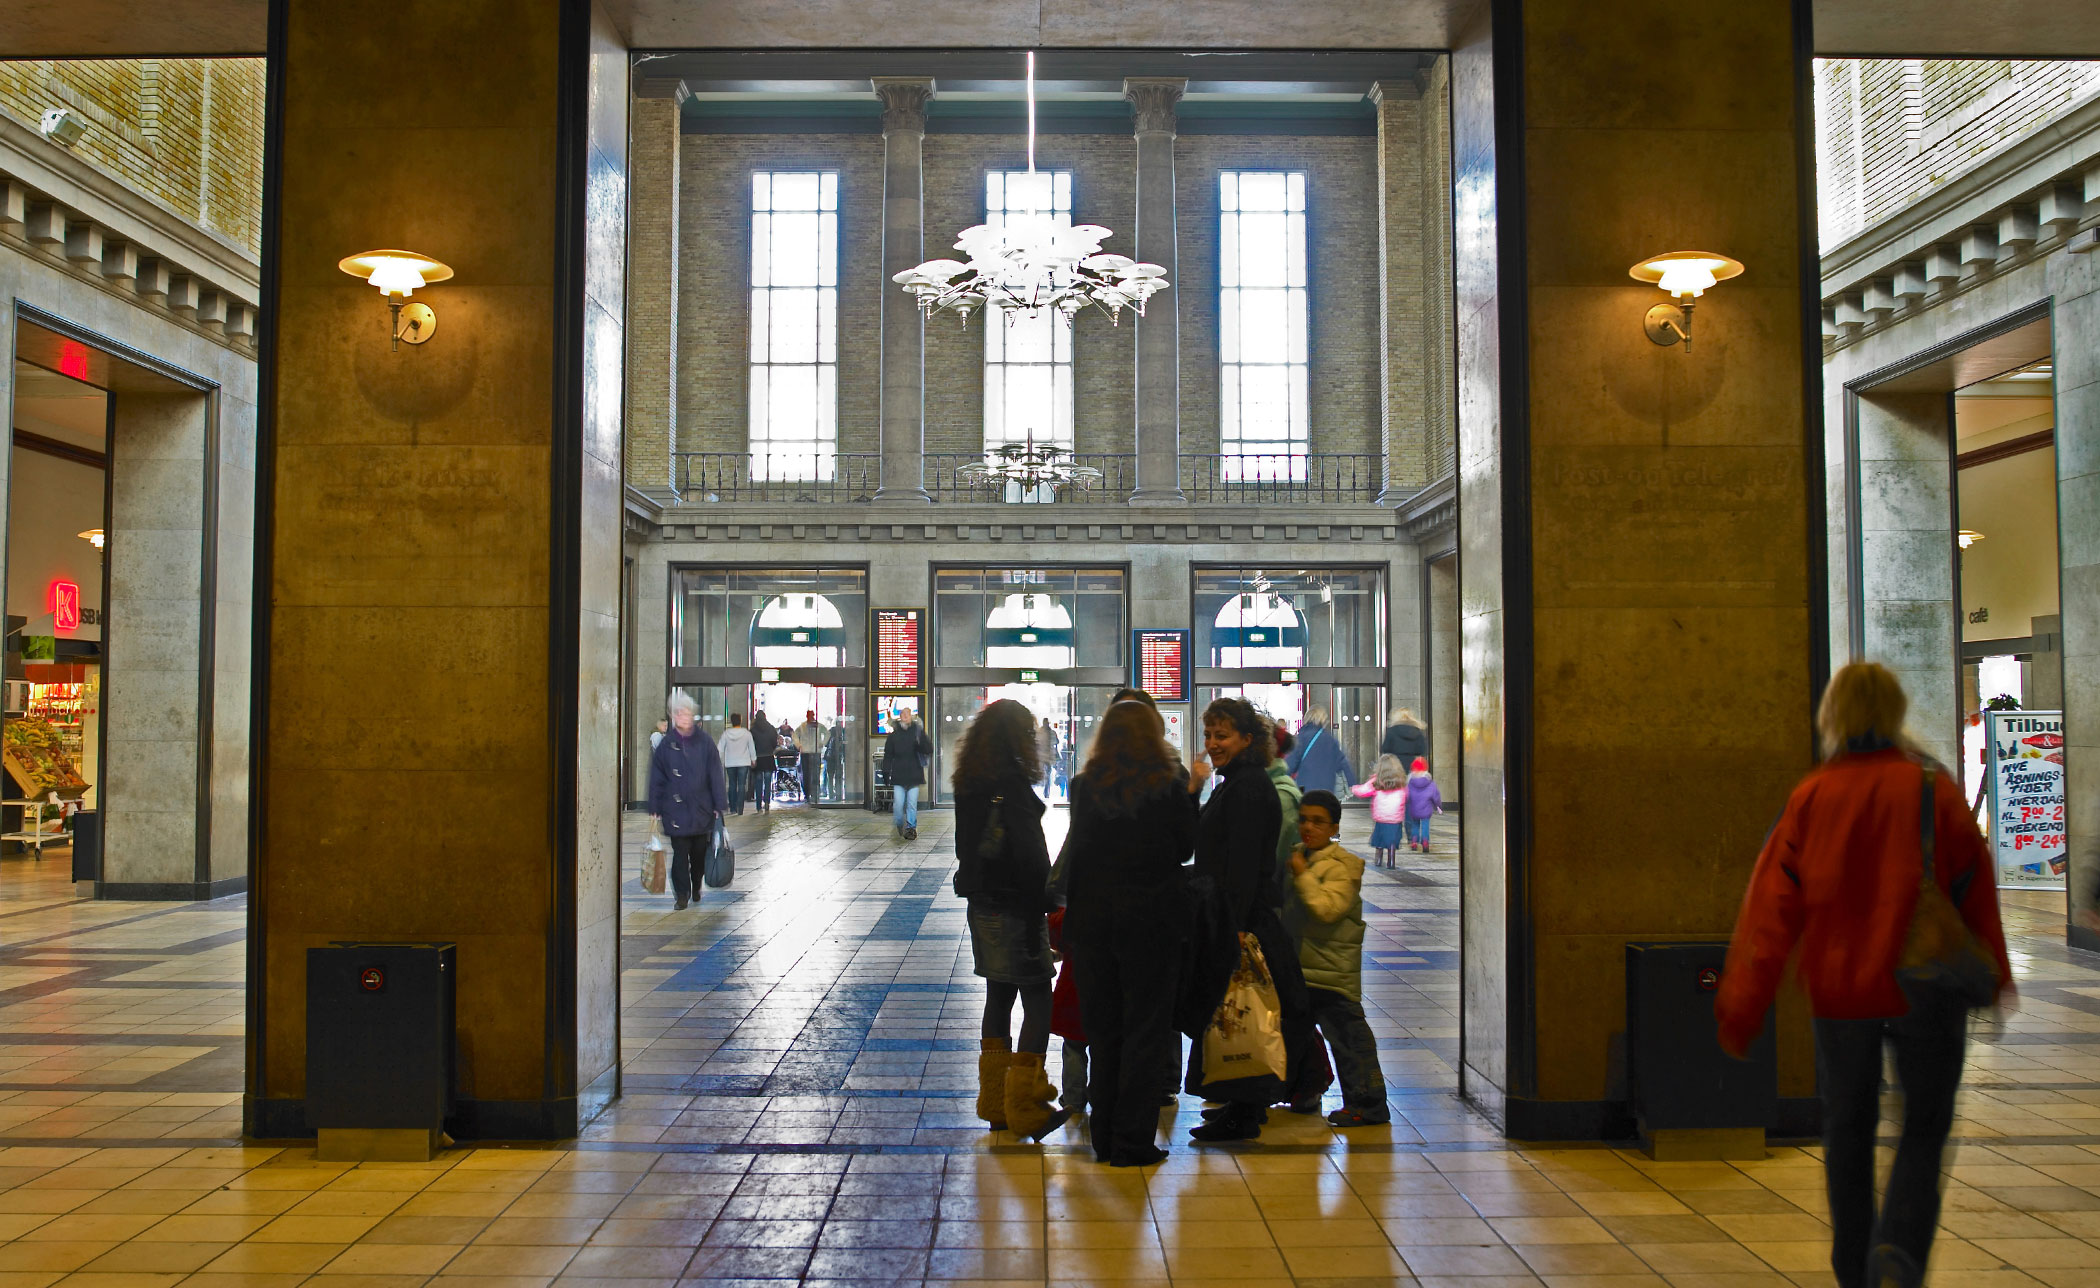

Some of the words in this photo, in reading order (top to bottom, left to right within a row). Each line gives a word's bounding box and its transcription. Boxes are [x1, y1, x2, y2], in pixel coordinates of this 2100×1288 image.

[60, 589, 74, 623] K
[1969, 607, 1988, 624] café
[2001, 760, 2028, 773] NYE
[2009, 782, 2053, 794] TIDER
[2005, 822, 2063, 834] WEEKEND
